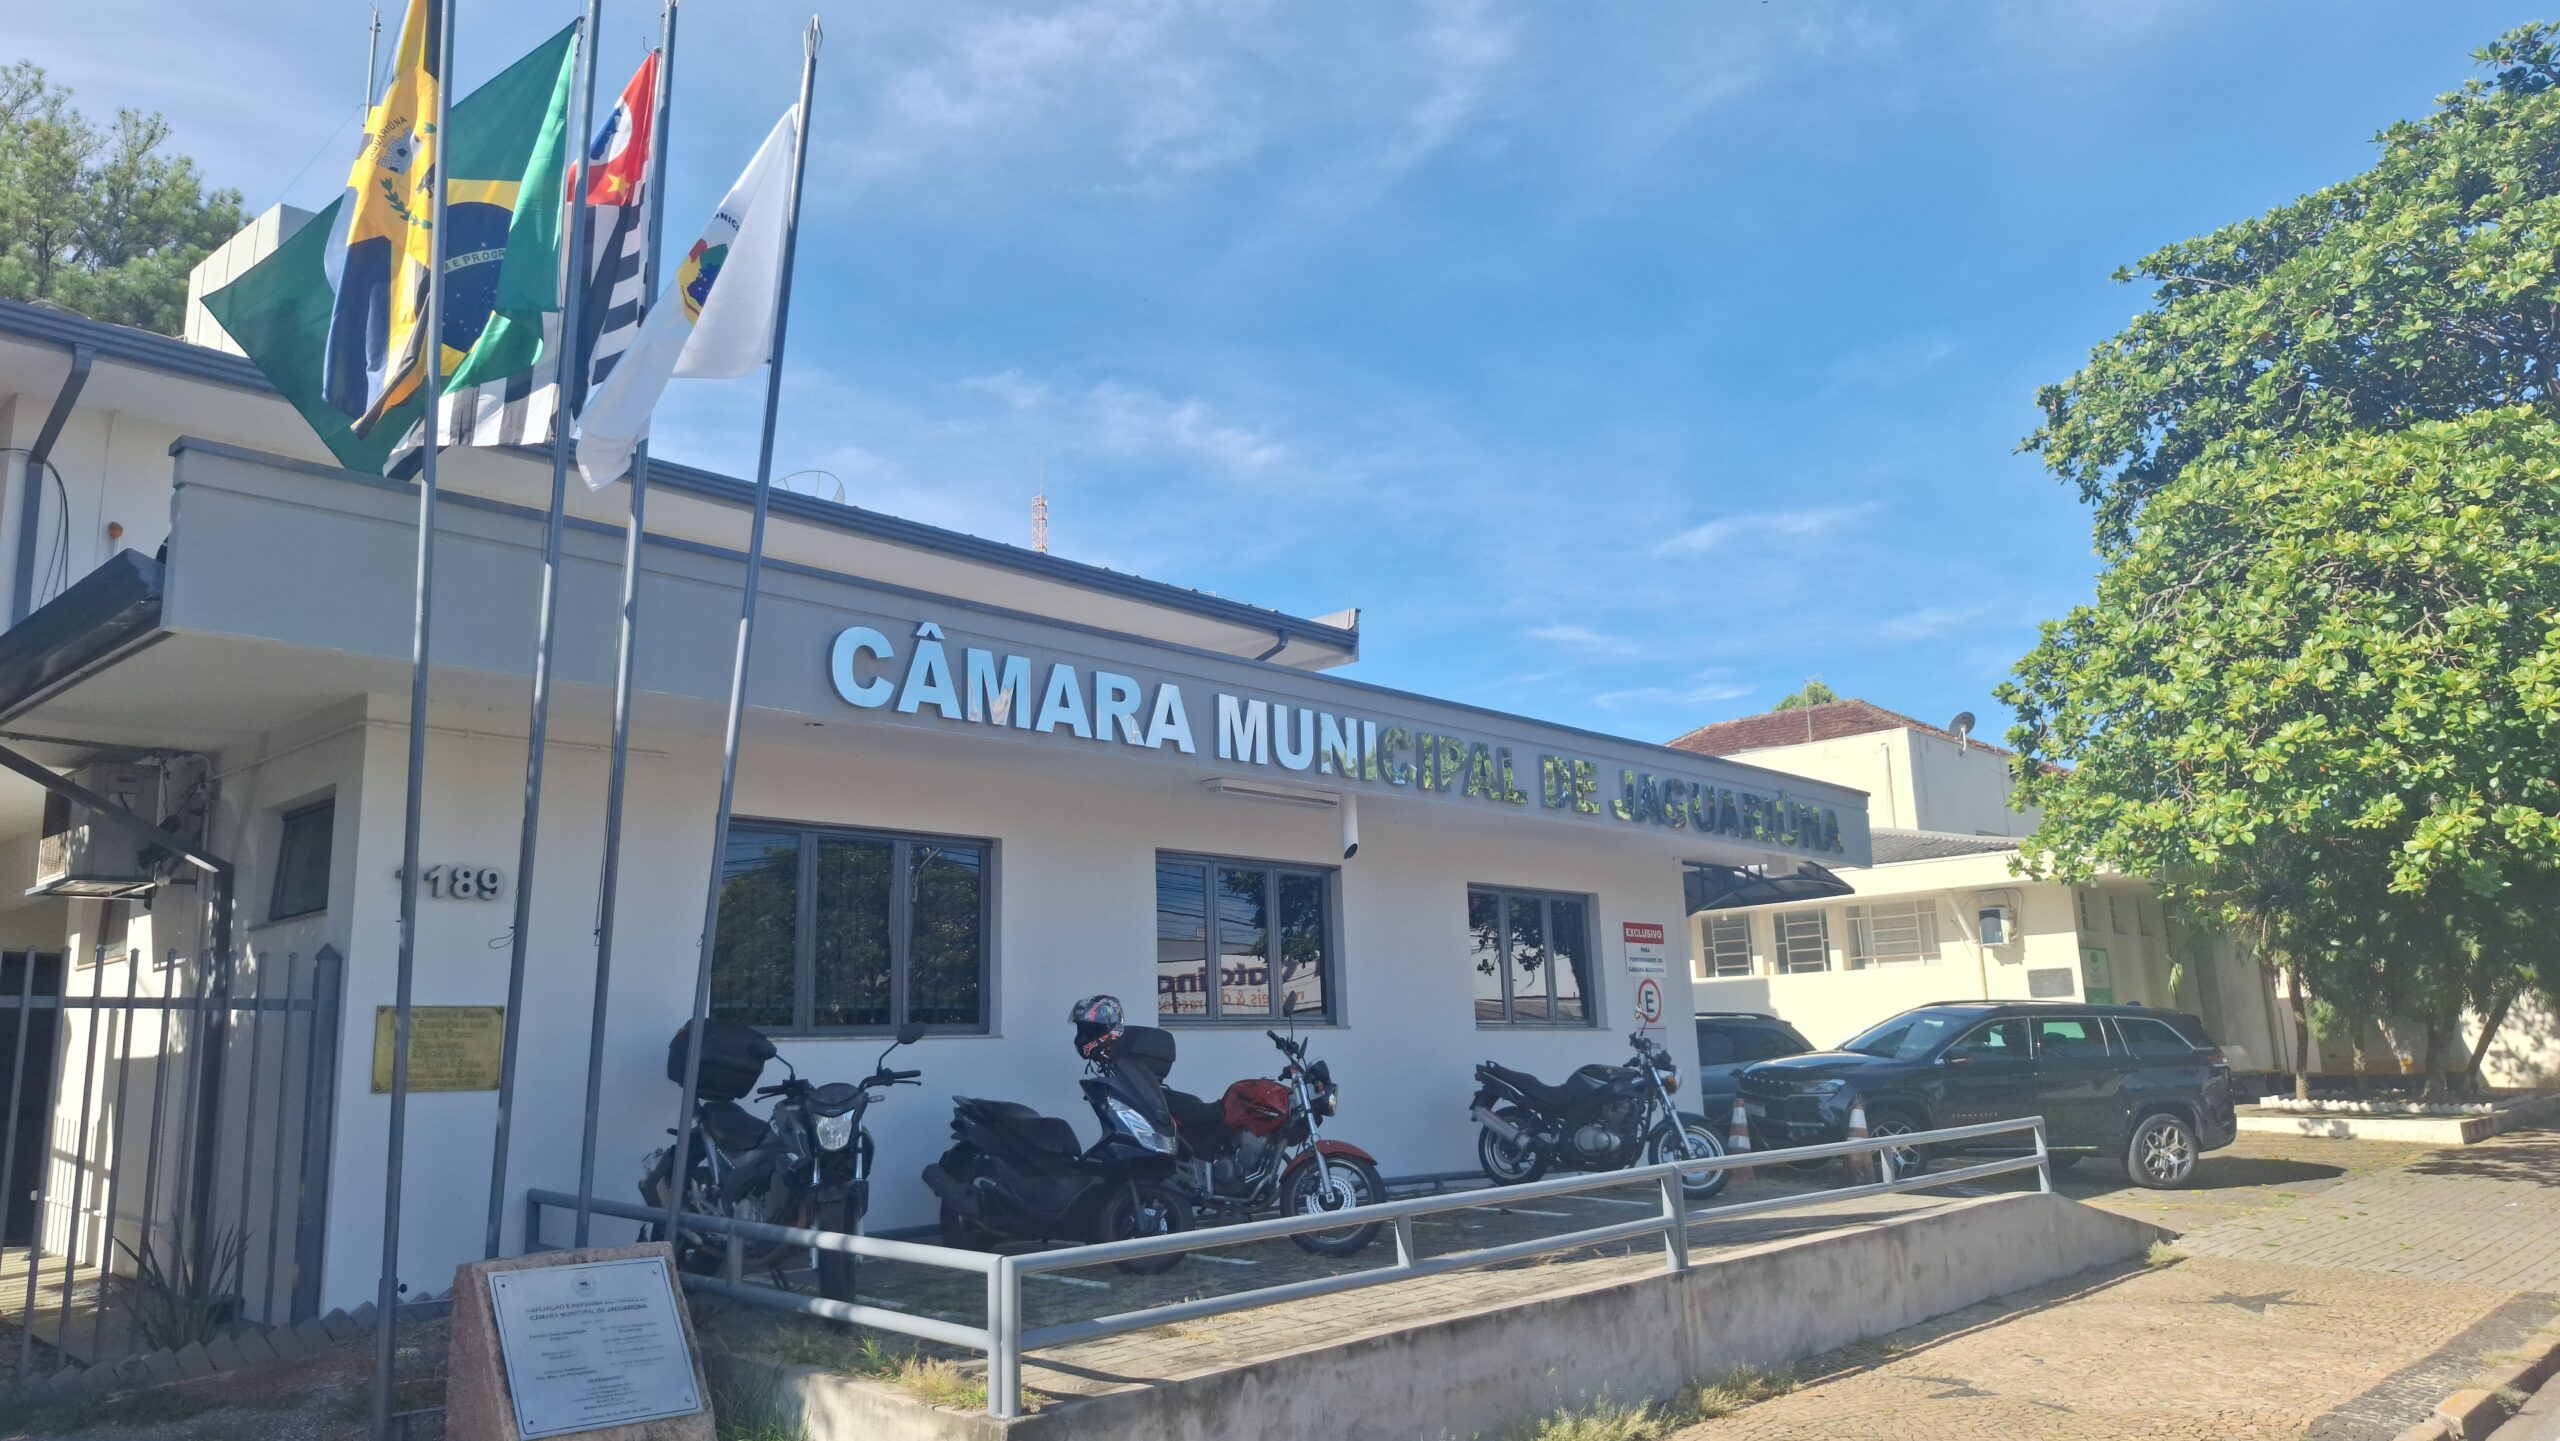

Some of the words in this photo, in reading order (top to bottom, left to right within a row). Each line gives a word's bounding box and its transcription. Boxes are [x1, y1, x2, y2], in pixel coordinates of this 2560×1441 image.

[462, 249, 505, 264] PROGR
[829, 621, 1196, 754] CÂMARA
[1215, 693, 1528, 804] MUNICIPAL
[1539, 753, 1601, 815] DE
[1613, 769, 1845, 854] JAGUARIÚNA
[395, 864, 505, 901] 189
[1625, 927, 1662, 939] EXCLUSIVO
[1645, 990, 1655, 1012] E
